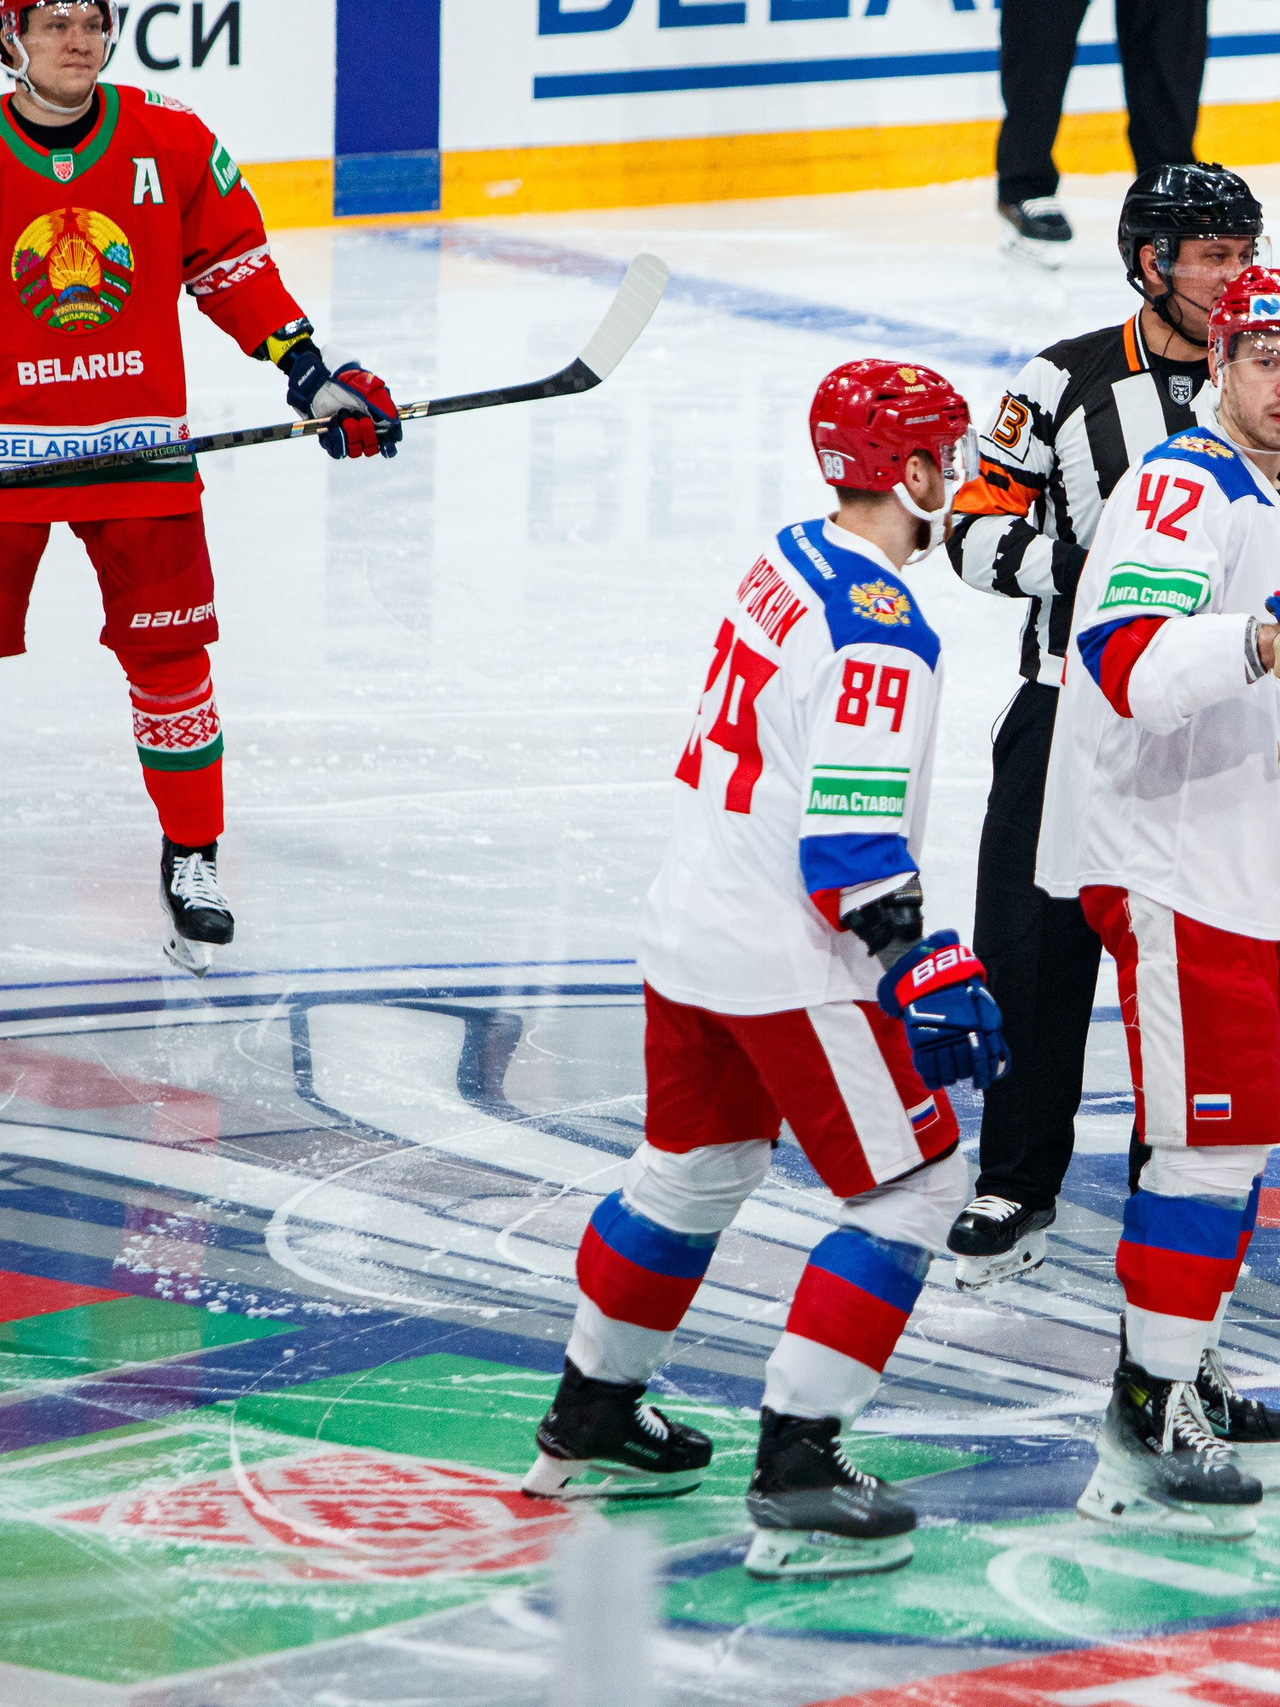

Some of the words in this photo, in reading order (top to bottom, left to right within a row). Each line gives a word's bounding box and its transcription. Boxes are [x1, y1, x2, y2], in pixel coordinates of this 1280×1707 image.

[132, 157, 164, 205] A
[17, 350, 145, 386] BELARUS
[140, 444, 188, 460] TRIGGER
[1136, 472, 1205, 542] 42
[129, 601, 216, 629] BAUER
[835, 658, 911, 733] 89
[811, 789, 850, 811] ЛИГА
